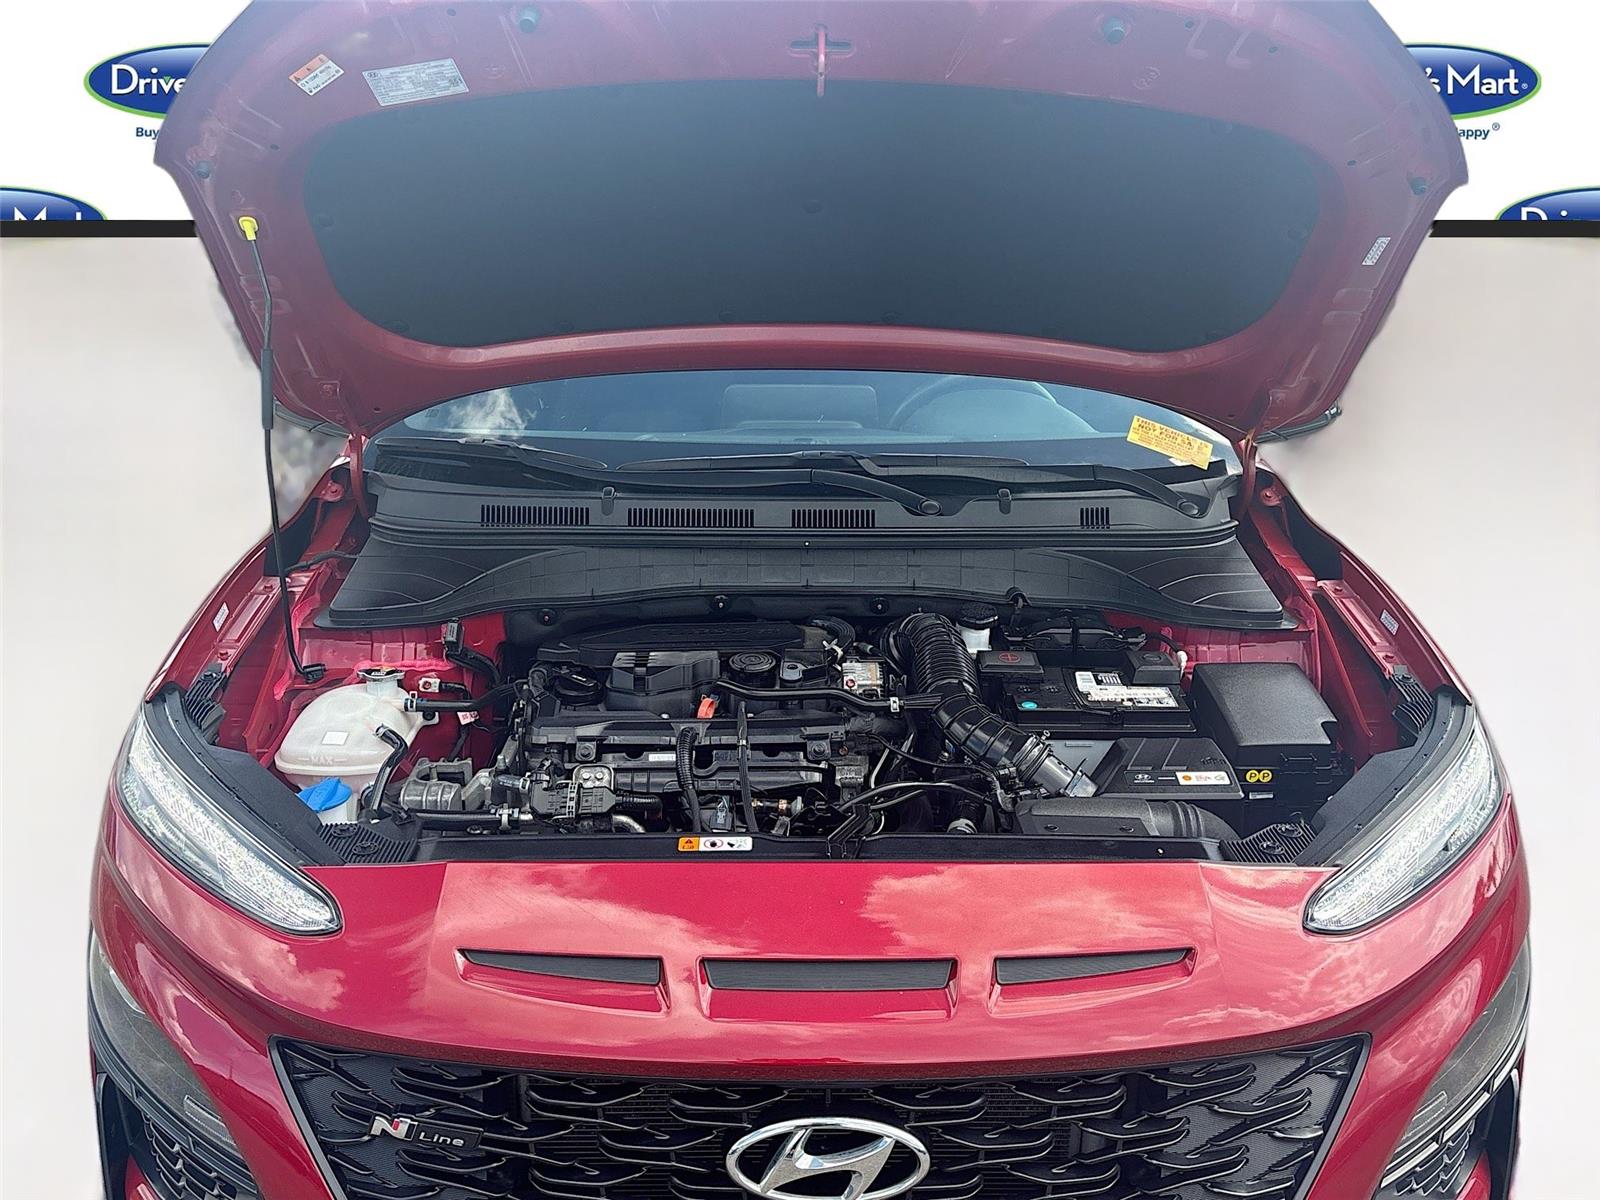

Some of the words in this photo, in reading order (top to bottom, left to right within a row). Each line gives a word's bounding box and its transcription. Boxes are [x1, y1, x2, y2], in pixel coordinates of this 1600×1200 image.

[135, 126, 160, 140] Buy
[1457, 126, 1490, 140] appy
[419, 1132, 465, 1147] Line
